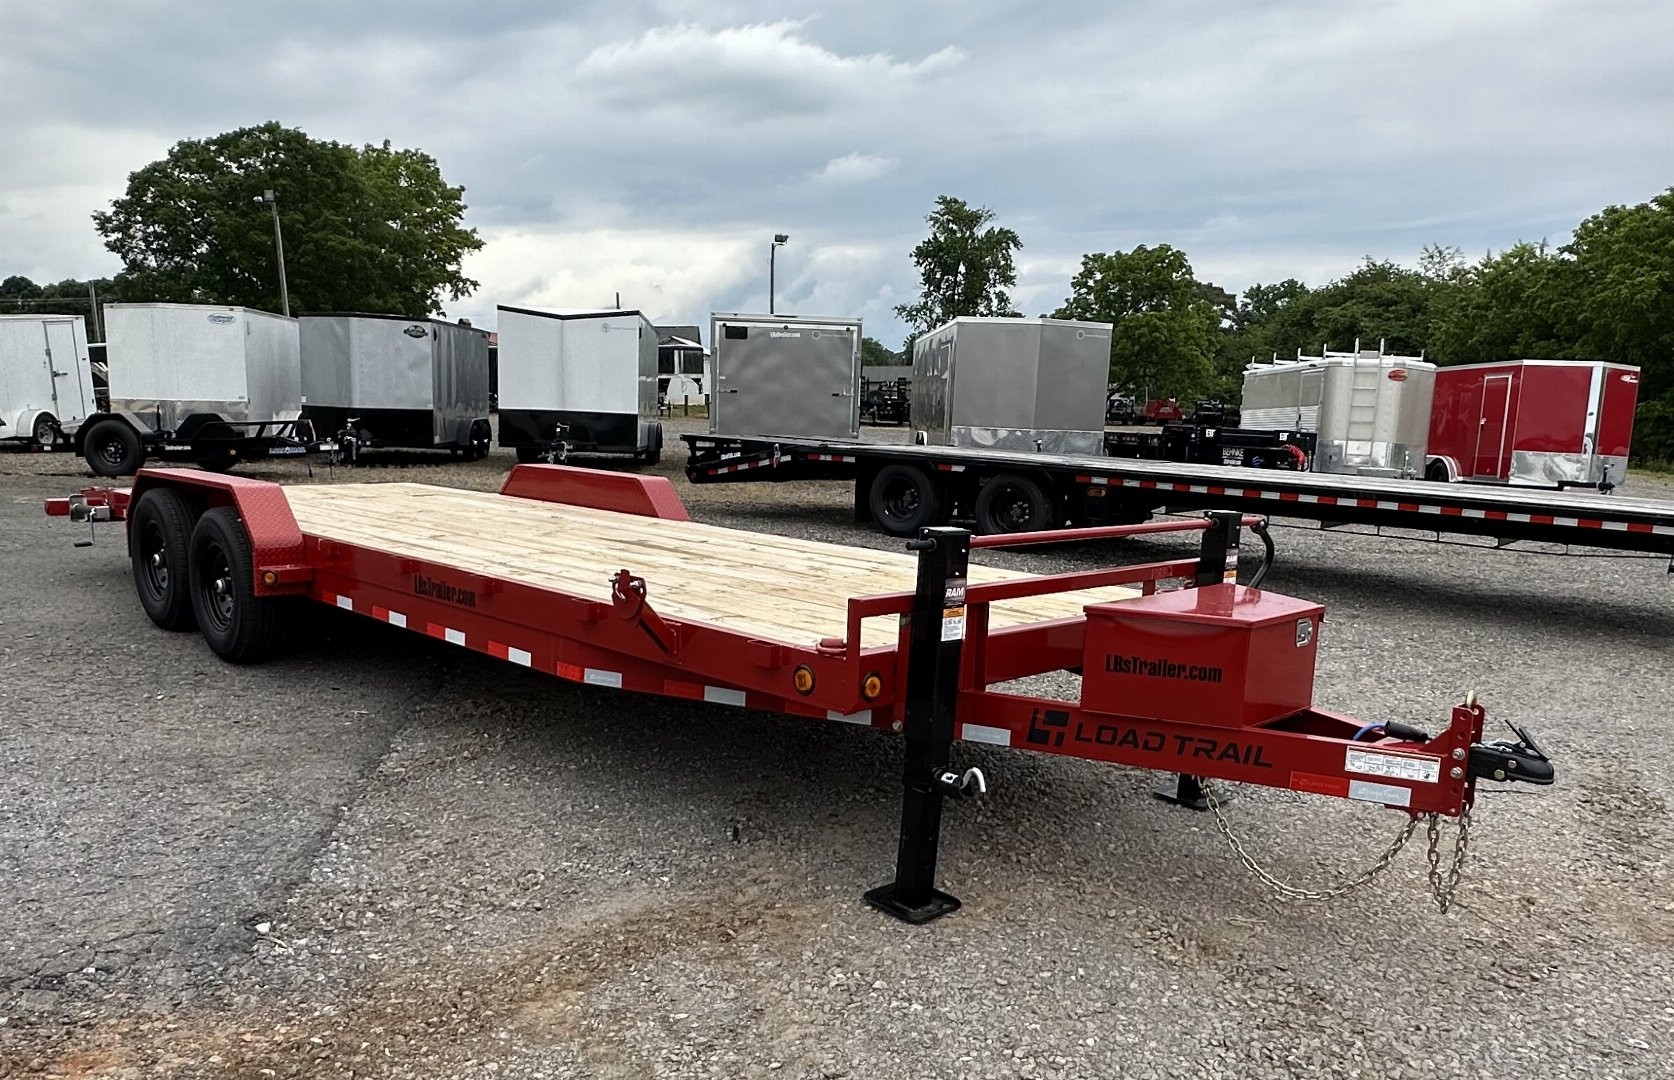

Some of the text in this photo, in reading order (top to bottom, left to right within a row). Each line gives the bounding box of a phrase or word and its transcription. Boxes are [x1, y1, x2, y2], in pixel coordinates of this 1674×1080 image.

[945, 586, 965, 598] RAM
[1105, 653, 1223, 683] LBsTrailer.com
[1075, 721, 1274, 769] LOAD TRAIL
